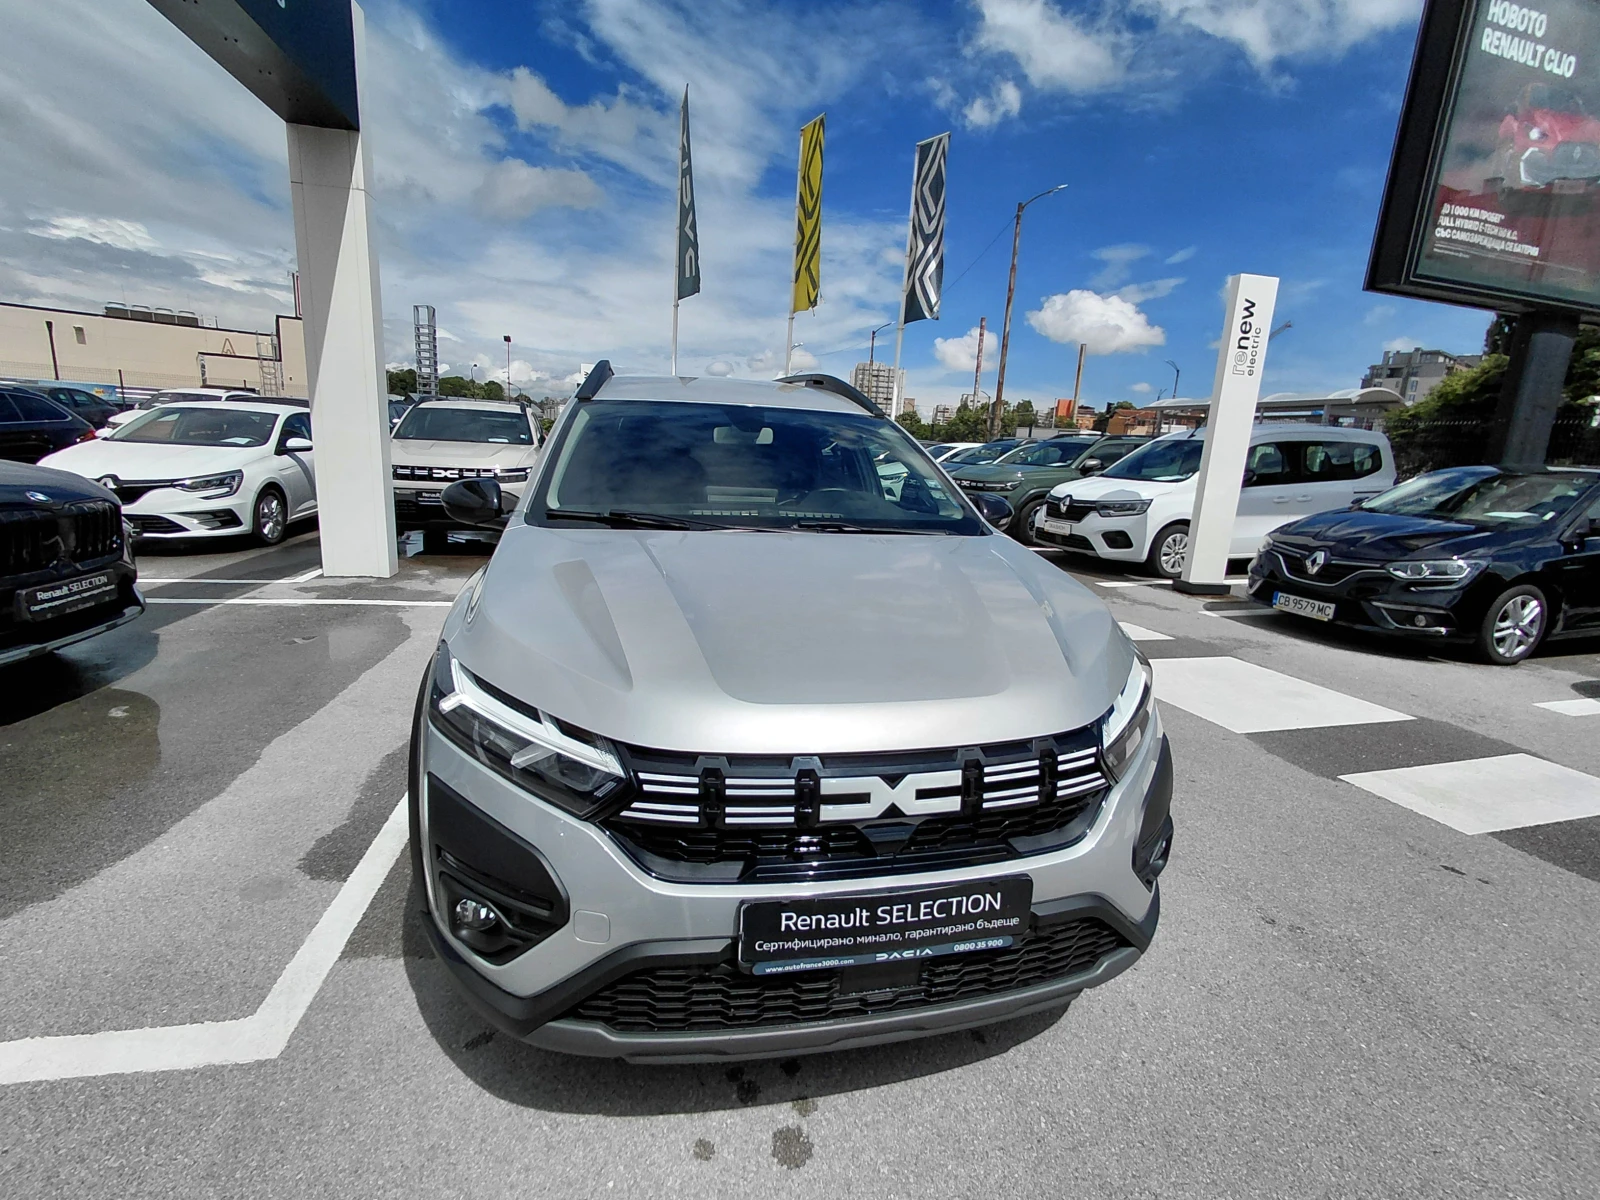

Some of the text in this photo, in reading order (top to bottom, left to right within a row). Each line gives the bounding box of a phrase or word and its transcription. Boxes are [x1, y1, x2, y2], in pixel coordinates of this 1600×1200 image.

[1487, 0, 1547, 38] НОВОТО
[1481, 27, 1576, 78] RENAULT CLIO
[1435, 227, 1452, 238] СЪС
[1454, 218, 1479, 231] HYBRID
[1232, 298, 1256, 376] renew
[1246, 327, 1262, 377] electric
[36, 585, 69, 601] Renault
[69, 575, 108, 593] SELECTION
[1278, 595, 1332, 617] CB 9579 MC
[780, 892, 1002, 933] Renault SELECTION
[755, 916, 1020, 953] Сертифицирано минало, гарантирано бъдеще
[765, 938, 1003, 973] www.autofrance3000.com DACIA 0800 35 900
